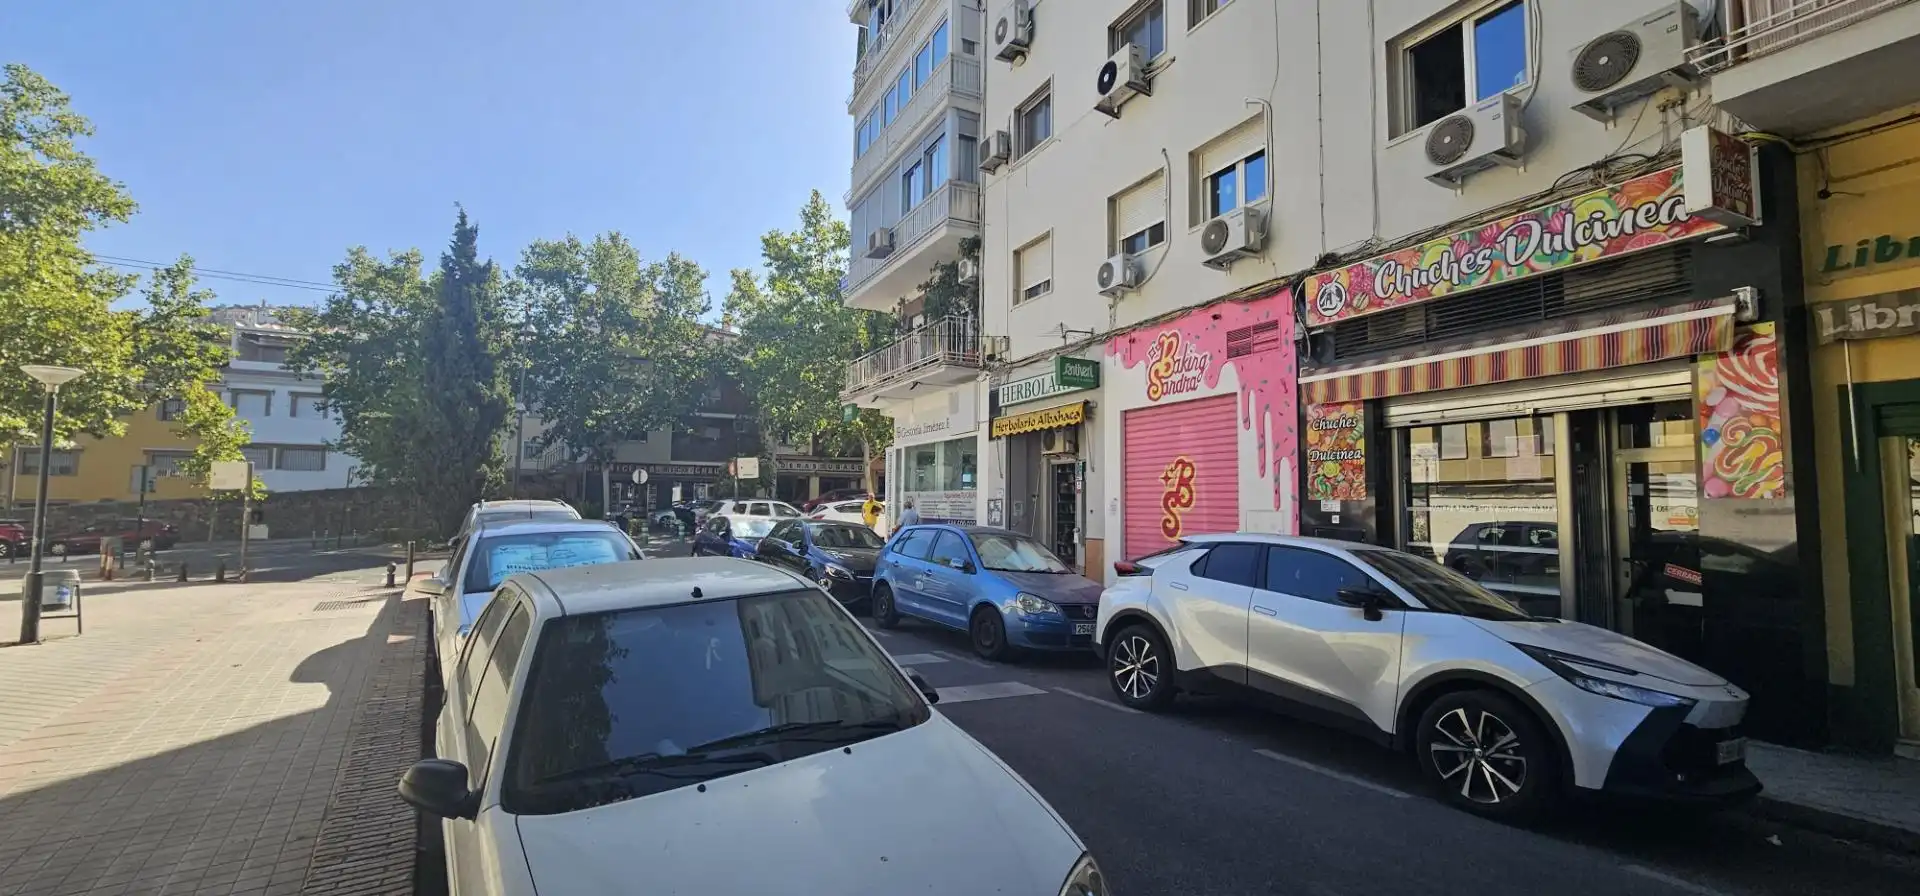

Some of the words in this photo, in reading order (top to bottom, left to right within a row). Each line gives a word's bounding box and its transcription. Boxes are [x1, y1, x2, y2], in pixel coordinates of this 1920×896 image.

[1374, 248, 1493, 299] Chuches
[1497, 195, 1691, 266] Dulcinea
[1156, 331, 1208, 383] Baking
[1001, 375, 1071, 404] HERBOLA
[1147, 360, 1198, 401] Sandra
[995, 416, 1035, 433] Herbolario
[1037, 409, 1081, 425] Albahaca
[1312, 414, 1357, 430] Chuches
[1310, 448, 1362, 462] Dulcinea
